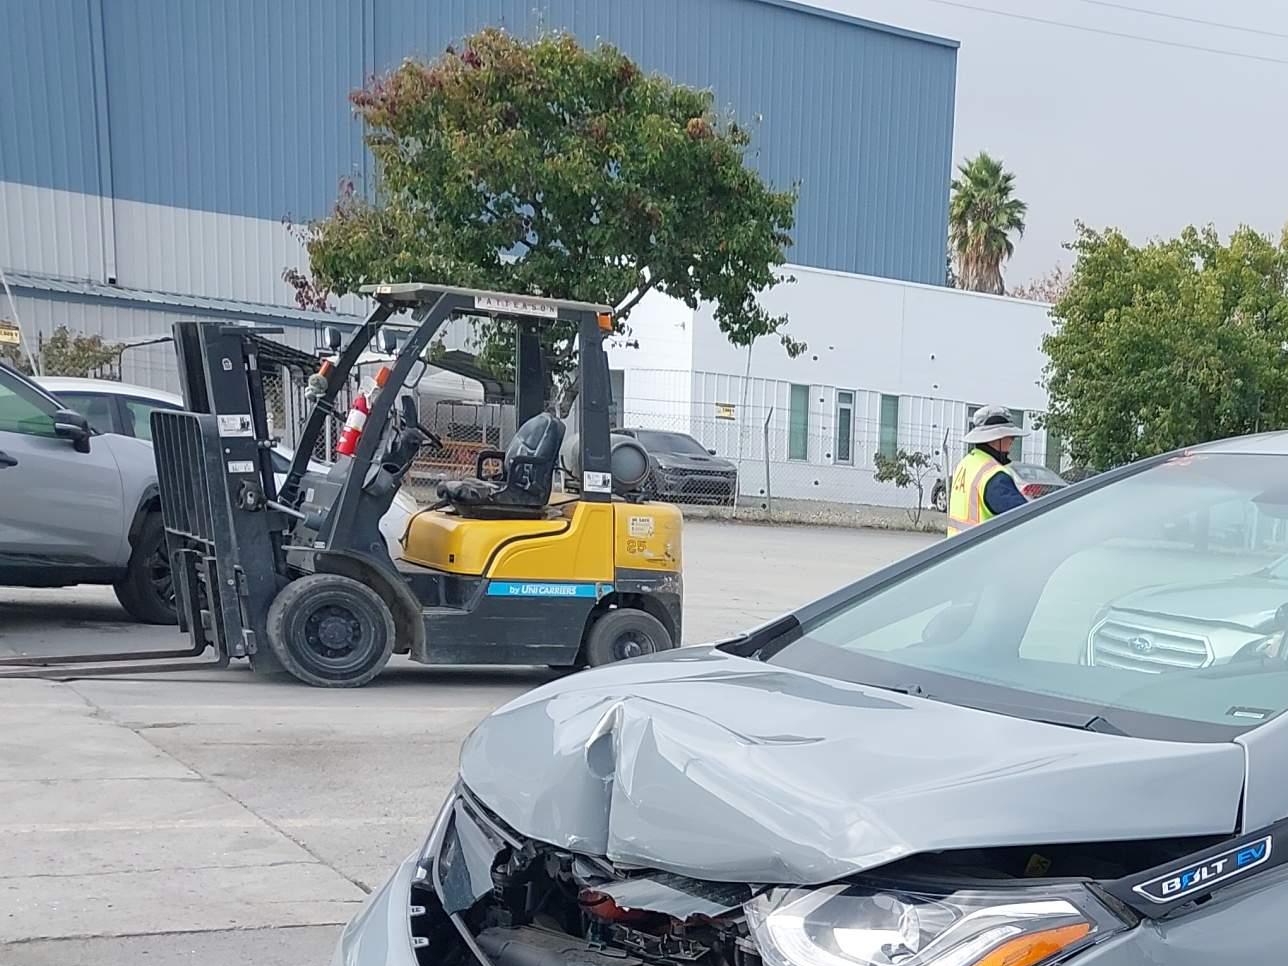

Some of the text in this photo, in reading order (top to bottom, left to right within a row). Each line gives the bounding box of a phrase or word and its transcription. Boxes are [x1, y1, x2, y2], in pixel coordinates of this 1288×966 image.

[477, 296, 555, 313] PATTERSON
[509, 585, 520, 595] by
[1161, 843, 1265, 896] BOLT EV
